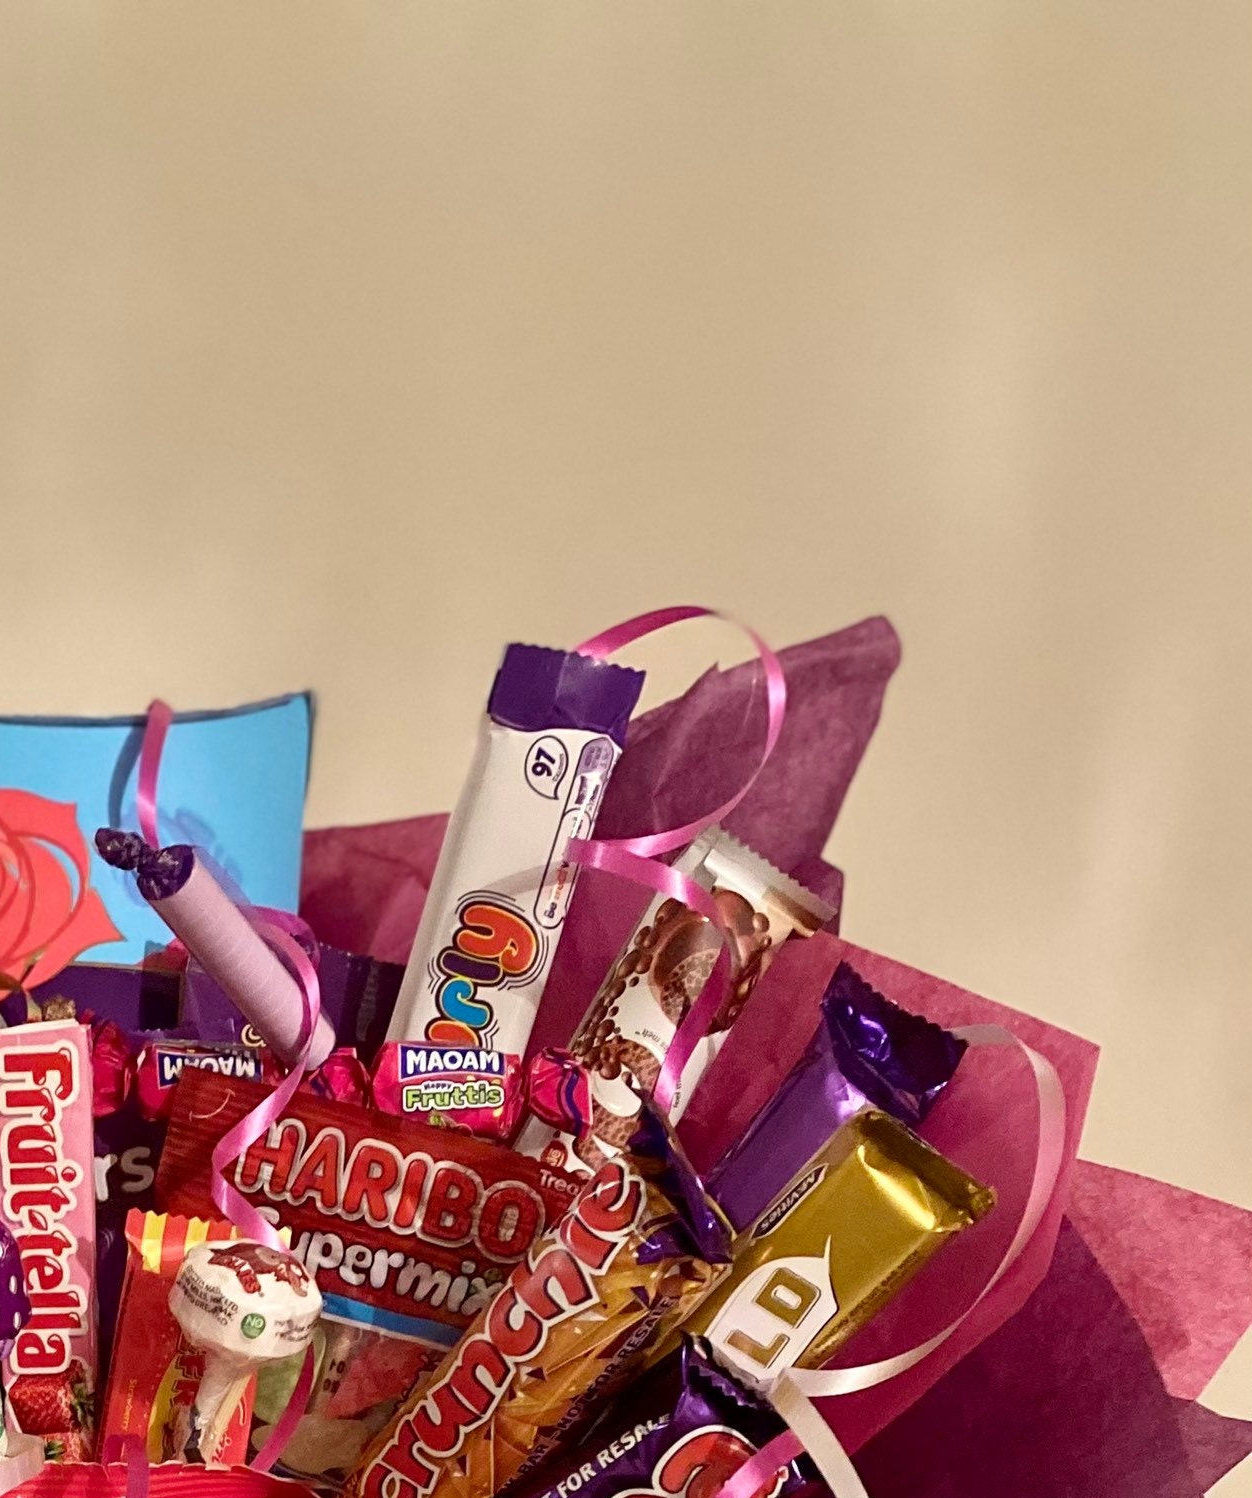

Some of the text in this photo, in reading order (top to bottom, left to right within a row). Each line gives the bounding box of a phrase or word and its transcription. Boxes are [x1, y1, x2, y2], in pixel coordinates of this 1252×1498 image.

[531, 746, 556, 778] 97
[406, 1049, 500, 1075] MAOAM
[406, 1083, 502, 1109] Fruttis
[238, 1120, 543, 1261] HARIBO
[596, 1413, 671, 1471] RESALE
